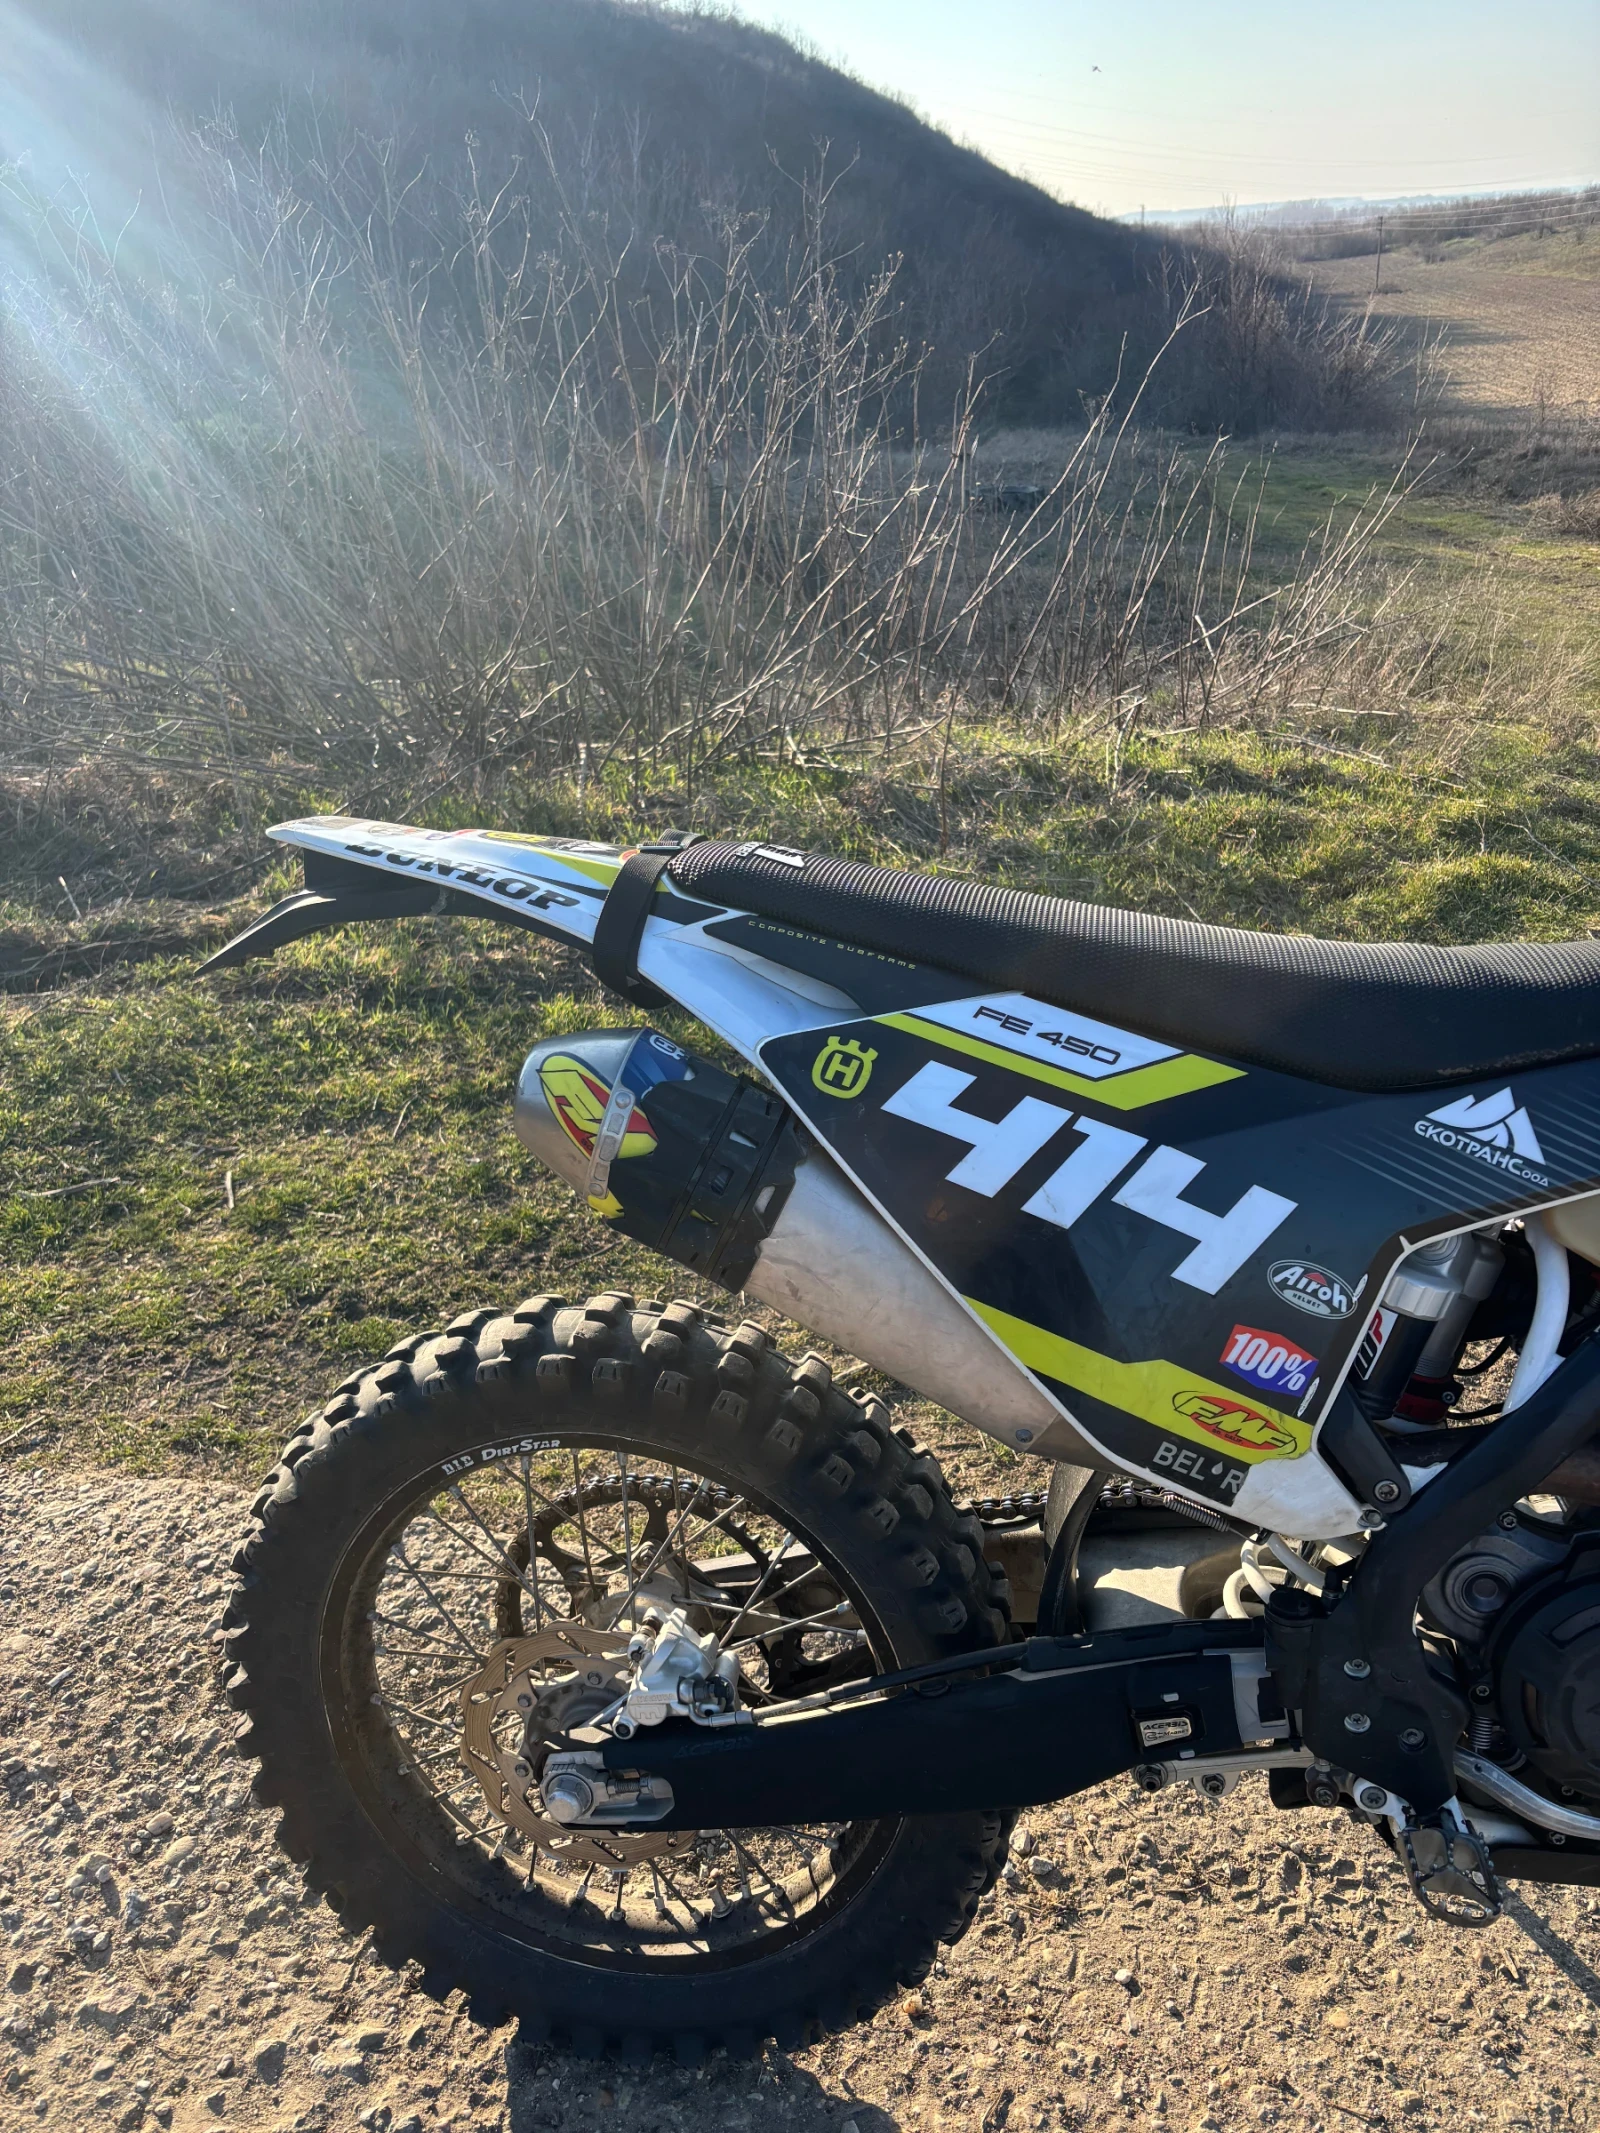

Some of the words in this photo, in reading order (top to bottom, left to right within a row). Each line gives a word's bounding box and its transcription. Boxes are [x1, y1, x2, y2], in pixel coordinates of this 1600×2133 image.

[345, 841, 580, 910] DUNLOP
[748, 920, 827, 944] COMPOSITE
[836, 943, 916, 970] SUBFRAME
[972, 1005, 1034, 1036] FE
[1036, 1031, 1121, 1066] 450
[880, 1060, 1299, 1296] 414
[1273, 1265, 1348, 1313] Airoh
[1292, 1292, 1322, 1309] HELMET
[1225, 1332, 1313, 1391] 100%
[1174, 1395, 1297, 1449] FMF
[1144, 1721, 1188, 1730] ACERBIS
